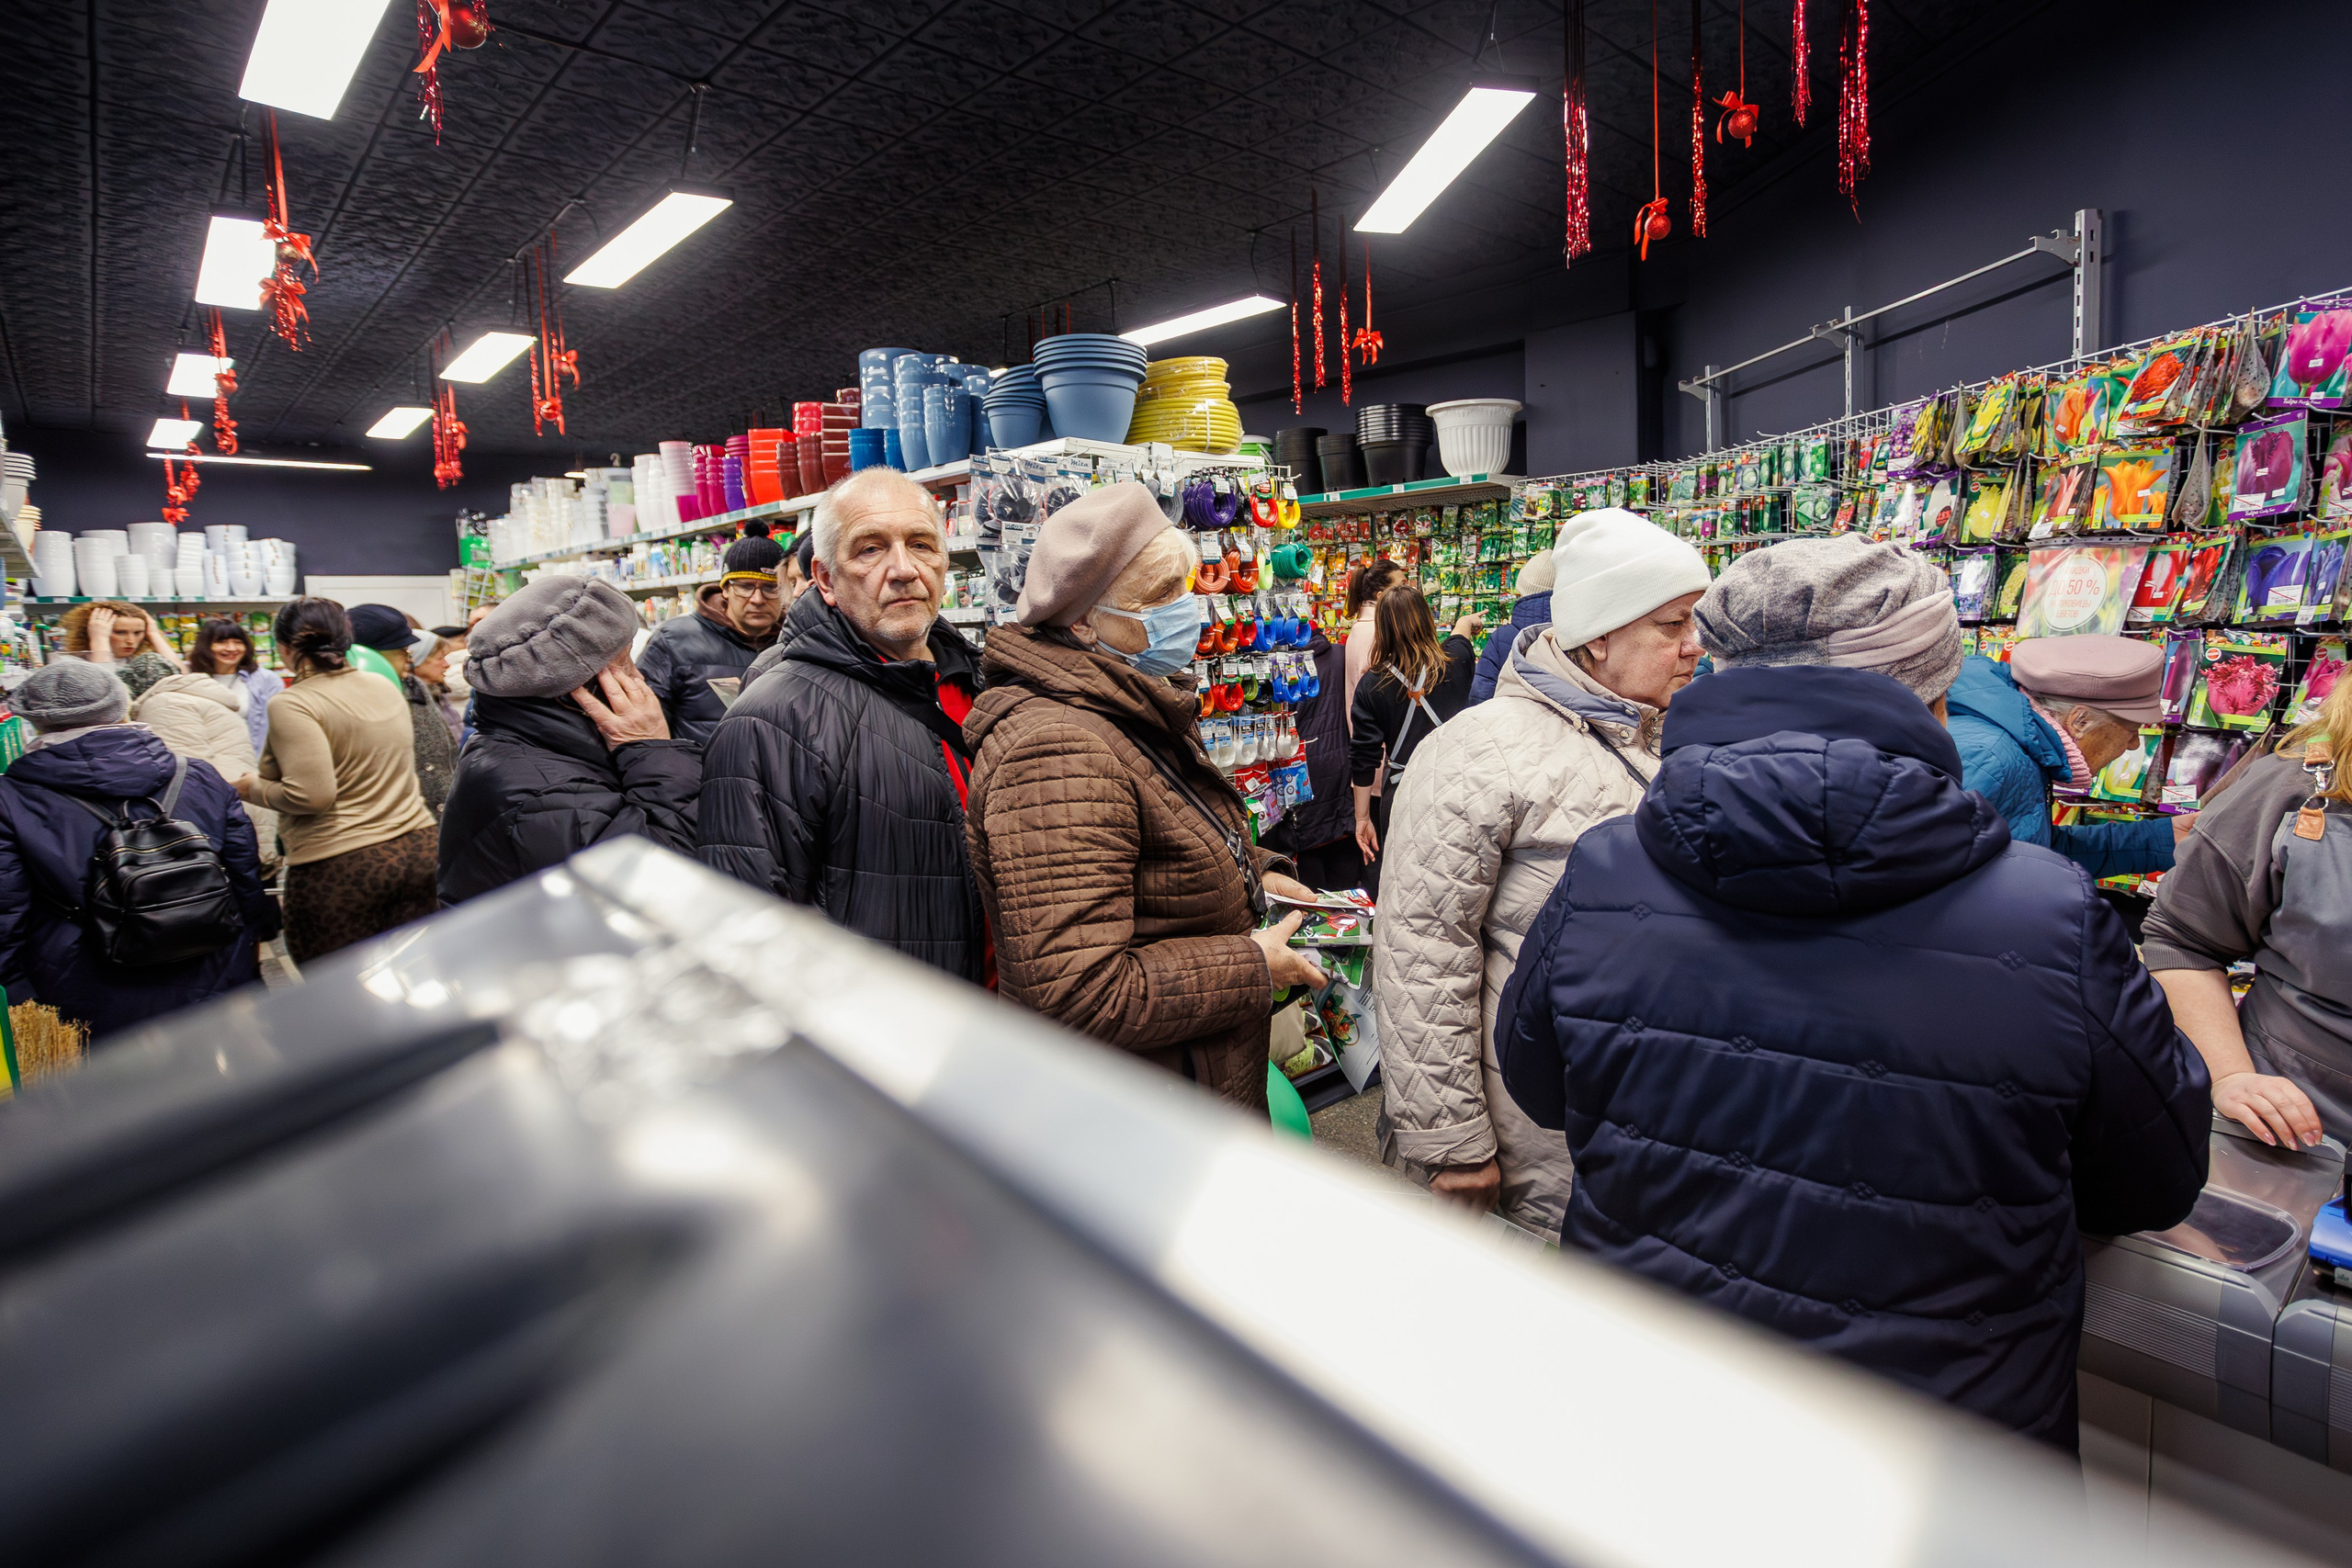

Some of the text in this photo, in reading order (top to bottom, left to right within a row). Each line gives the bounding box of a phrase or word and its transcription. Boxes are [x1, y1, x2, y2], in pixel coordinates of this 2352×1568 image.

[2299, 304, 2307, 312] 5
[1070, 458, 1089, 468] Mita
[2049, 579, 2100, 596] ДО 50 %
[2175, 806, 2190, 815] Tulipa
